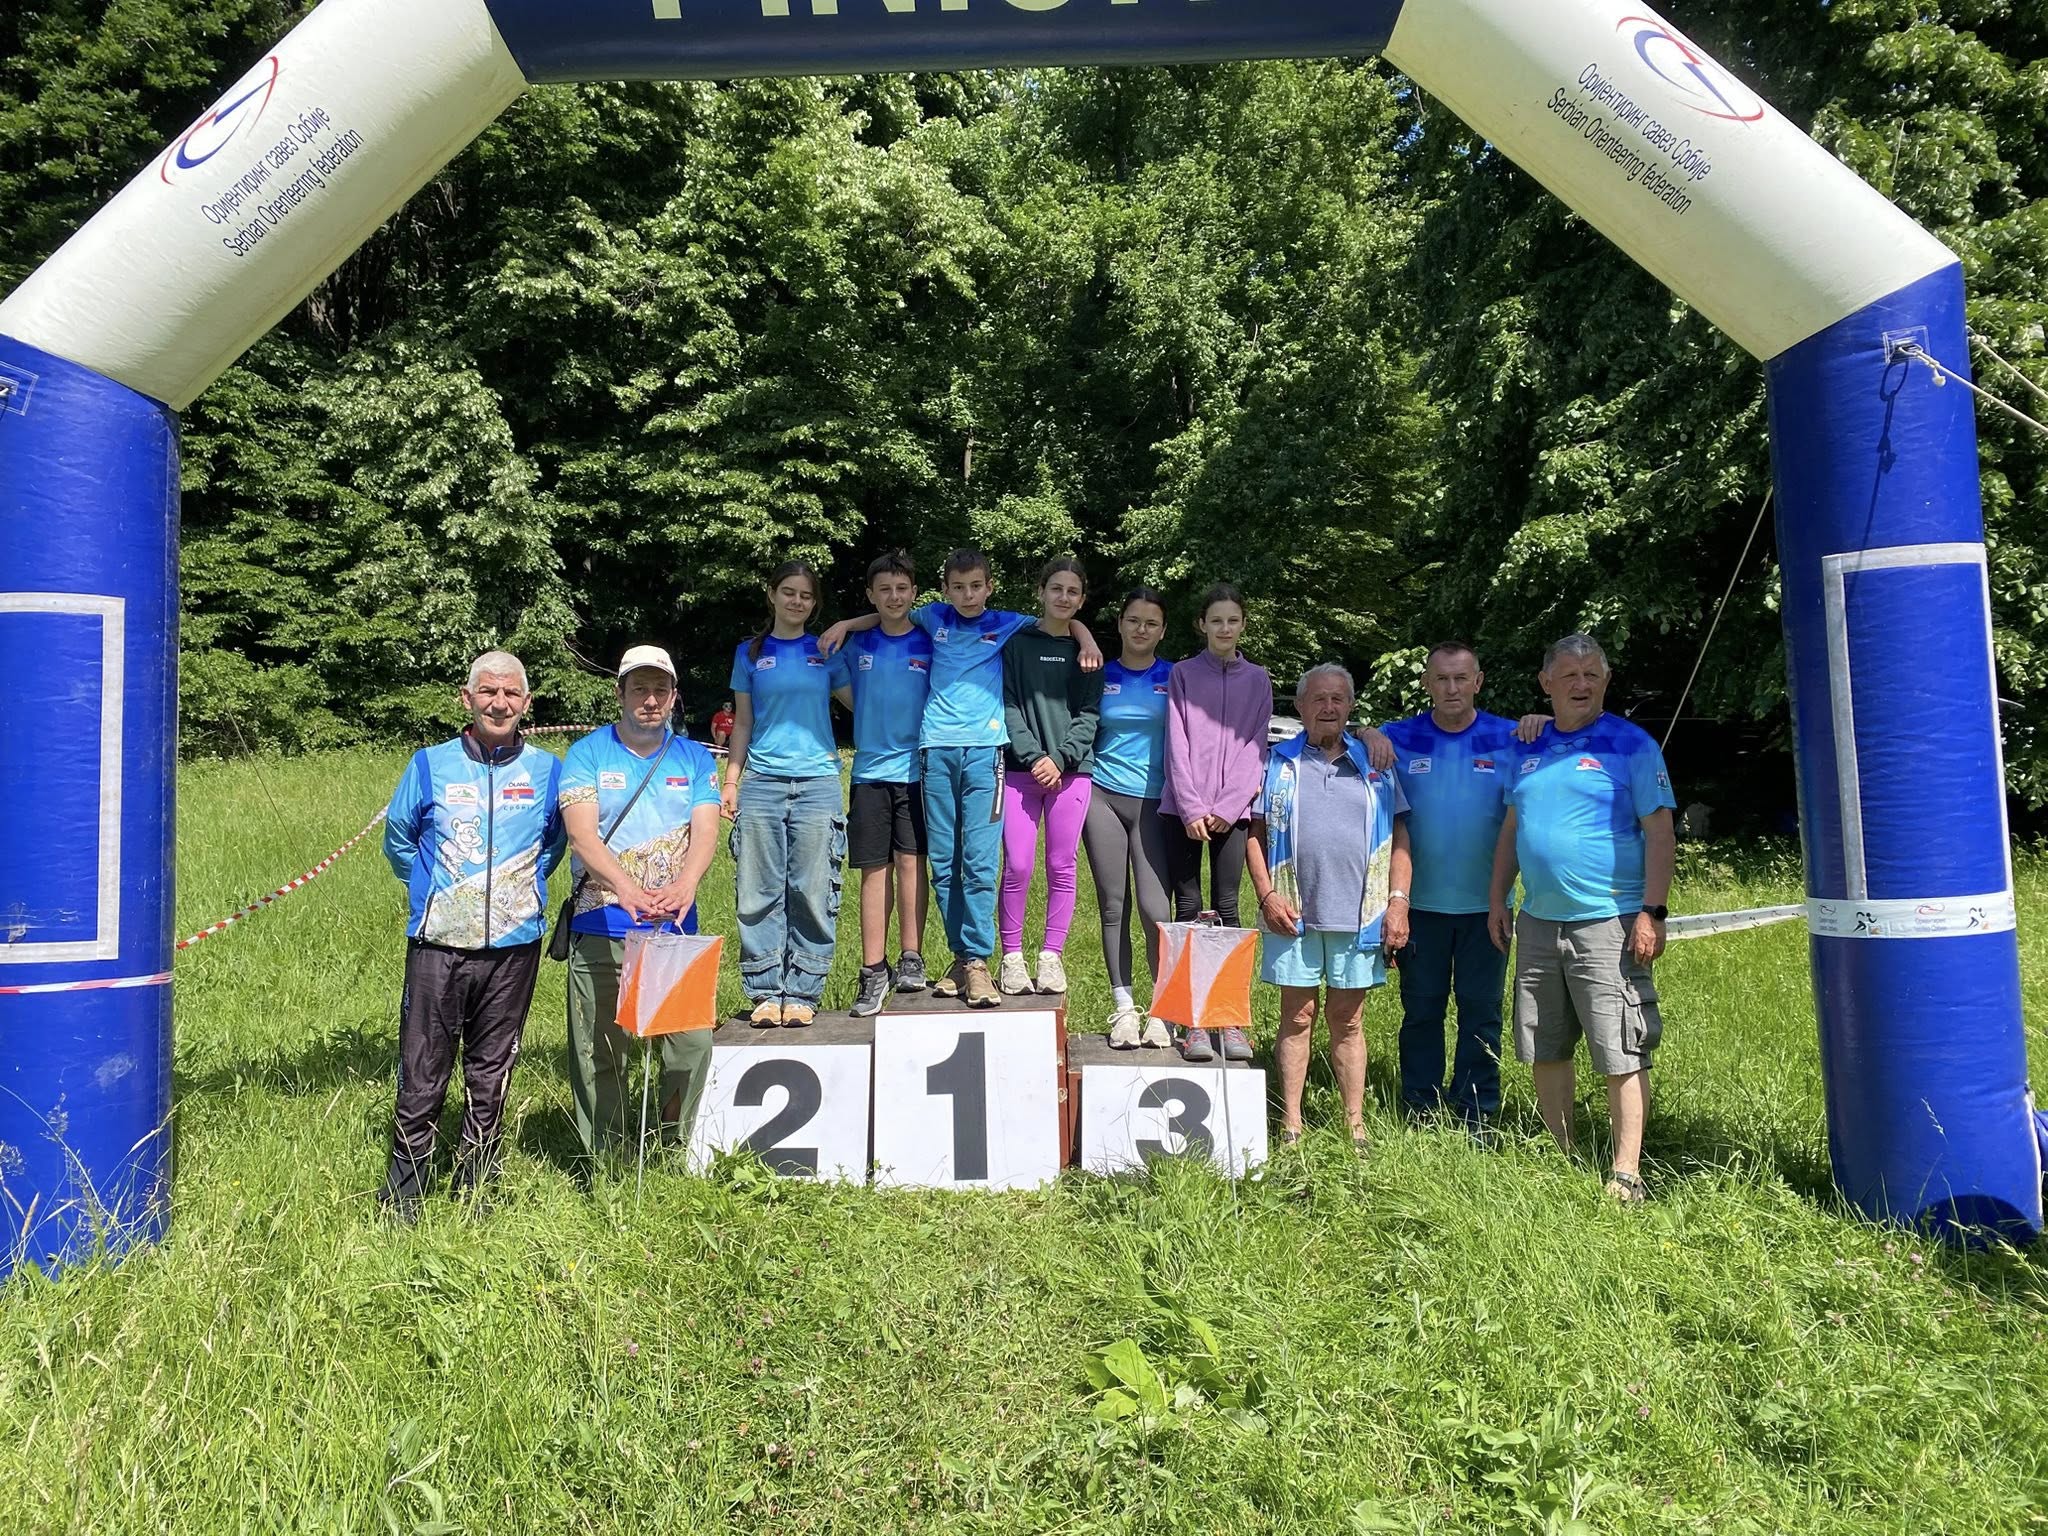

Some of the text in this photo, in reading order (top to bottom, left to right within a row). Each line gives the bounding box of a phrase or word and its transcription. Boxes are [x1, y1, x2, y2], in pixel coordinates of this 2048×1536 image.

[201, 106, 331, 225] Оријентиринг савез Србије
[1547, 87, 1692, 215] Serbian Orienteering federation
[1578, 63, 1712, 182] Оријентиринг савез Србије
[223, 128, 365, 257] Serbian Orienteering federation
[733, 1058, 822, 1177] 2
[926, 1032, 988, 1180] 1
[1135, 1077, 1215, 1165] 3
